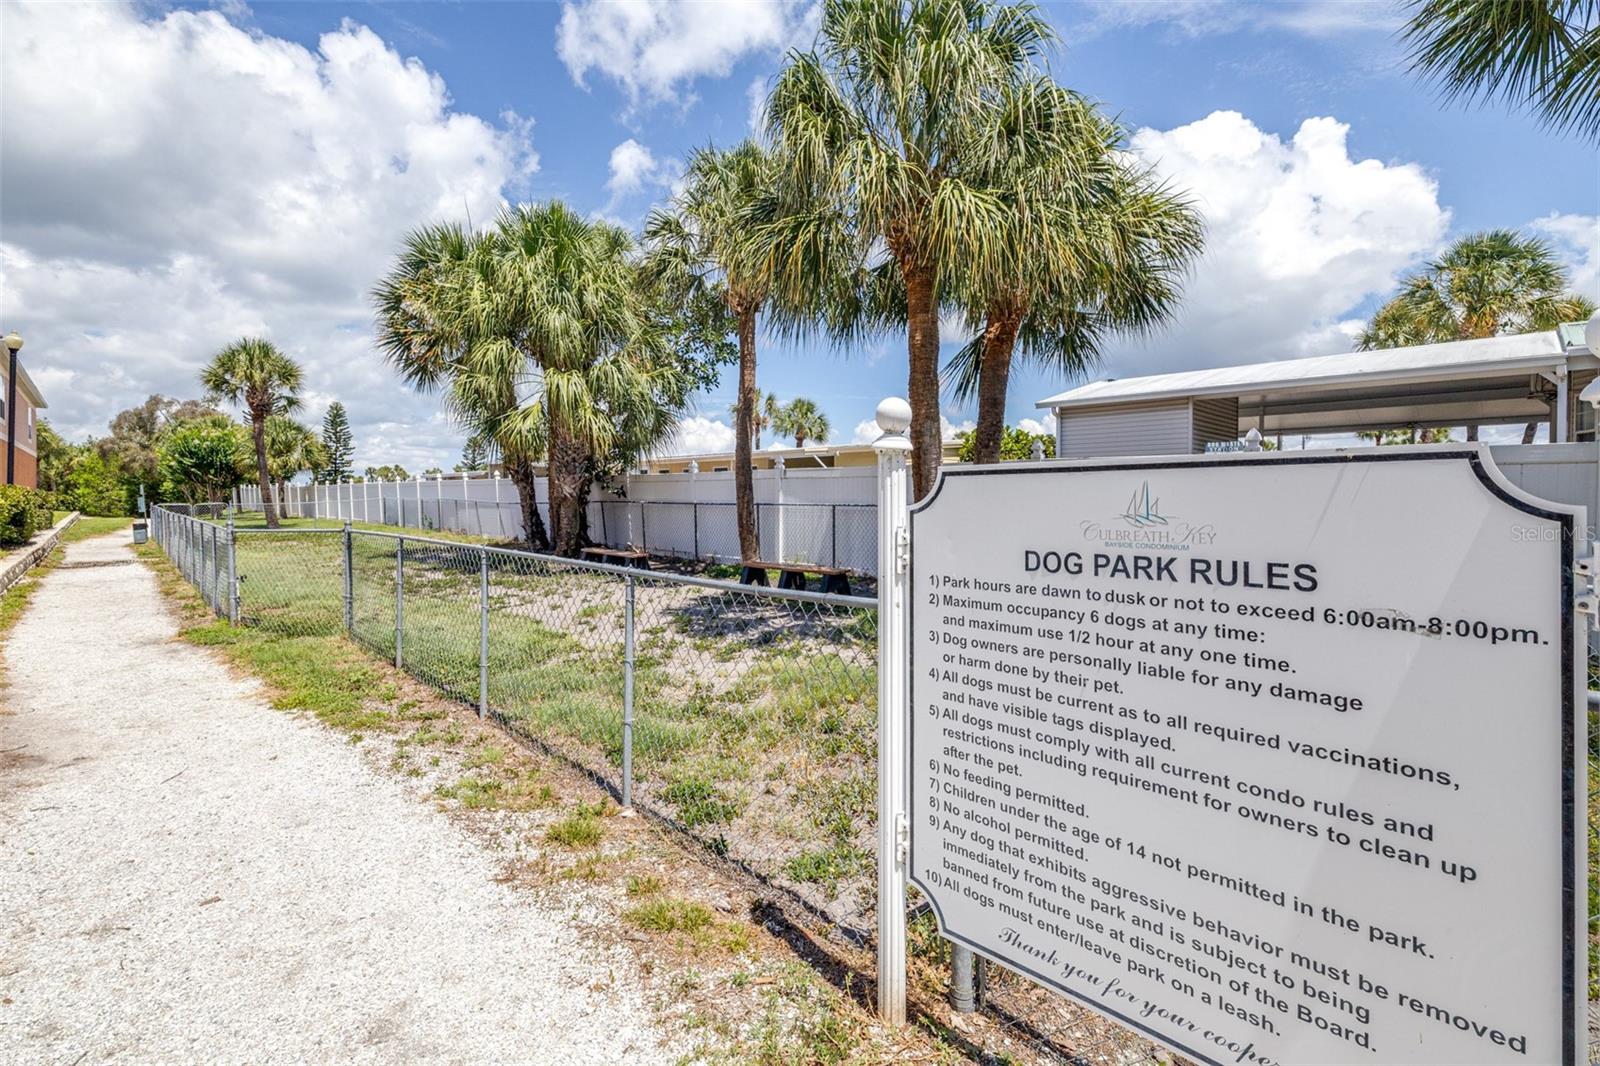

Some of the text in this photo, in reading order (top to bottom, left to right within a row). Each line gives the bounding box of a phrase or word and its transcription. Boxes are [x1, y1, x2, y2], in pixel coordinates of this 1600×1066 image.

[1024, 550, 1318, 593] DOG PARK RULES
[1104, 541, 1190, 551] BAYSIDE CONDOMINIUM
[929, 574, 1549, 646] 1) Park hours are dawn to dusk or not to exceed 6:00am-8:00pm.
[929, 592, 1265, 644] 2) Maximum occupancy 6 dogs at any time:
[942, 615, 1296, 674] and maximum use 1/2 hour at any one time.
[929, 630, 1364, 713] 3) Dog owners are personally liable for any damage
[942, 653, 1124, 695] or harm done by their pet.
[928, 667, 1460, 791] 4) All dogs must be current as to all required vaccinations,
[942, 691, 1176, 752] and have visible tags displayed.
[929, 704, 1434, 842] 5) All dogs must comply with all current condo rules and
[929, 759, 1089, 819] 6) No feeding permitted.
[943, 745, 1023, 777] after the pet.
[929, 796, 1088, 862] 8) No alcohol permitted.
[943, 727, 1477, 884] restrictions including requirement for owners to clean up
[929, 777, 1434, 960] 7) Children under the age of 14 not permitted in the park.
[925, 869, 1281, 1037] 10) All dogs must enter/leave park on a leash.
[929, 814, 1526, 1055] 9) Any dog that exhibits aggressive behavior must be removed
[943, 837, 1370, 1025] immediately from the park and is subject to being
[943, 856, 1376, 1053] banned from future use at discretion of the Board.
[998, 927, 1281, 1066] Thank you for your coope
